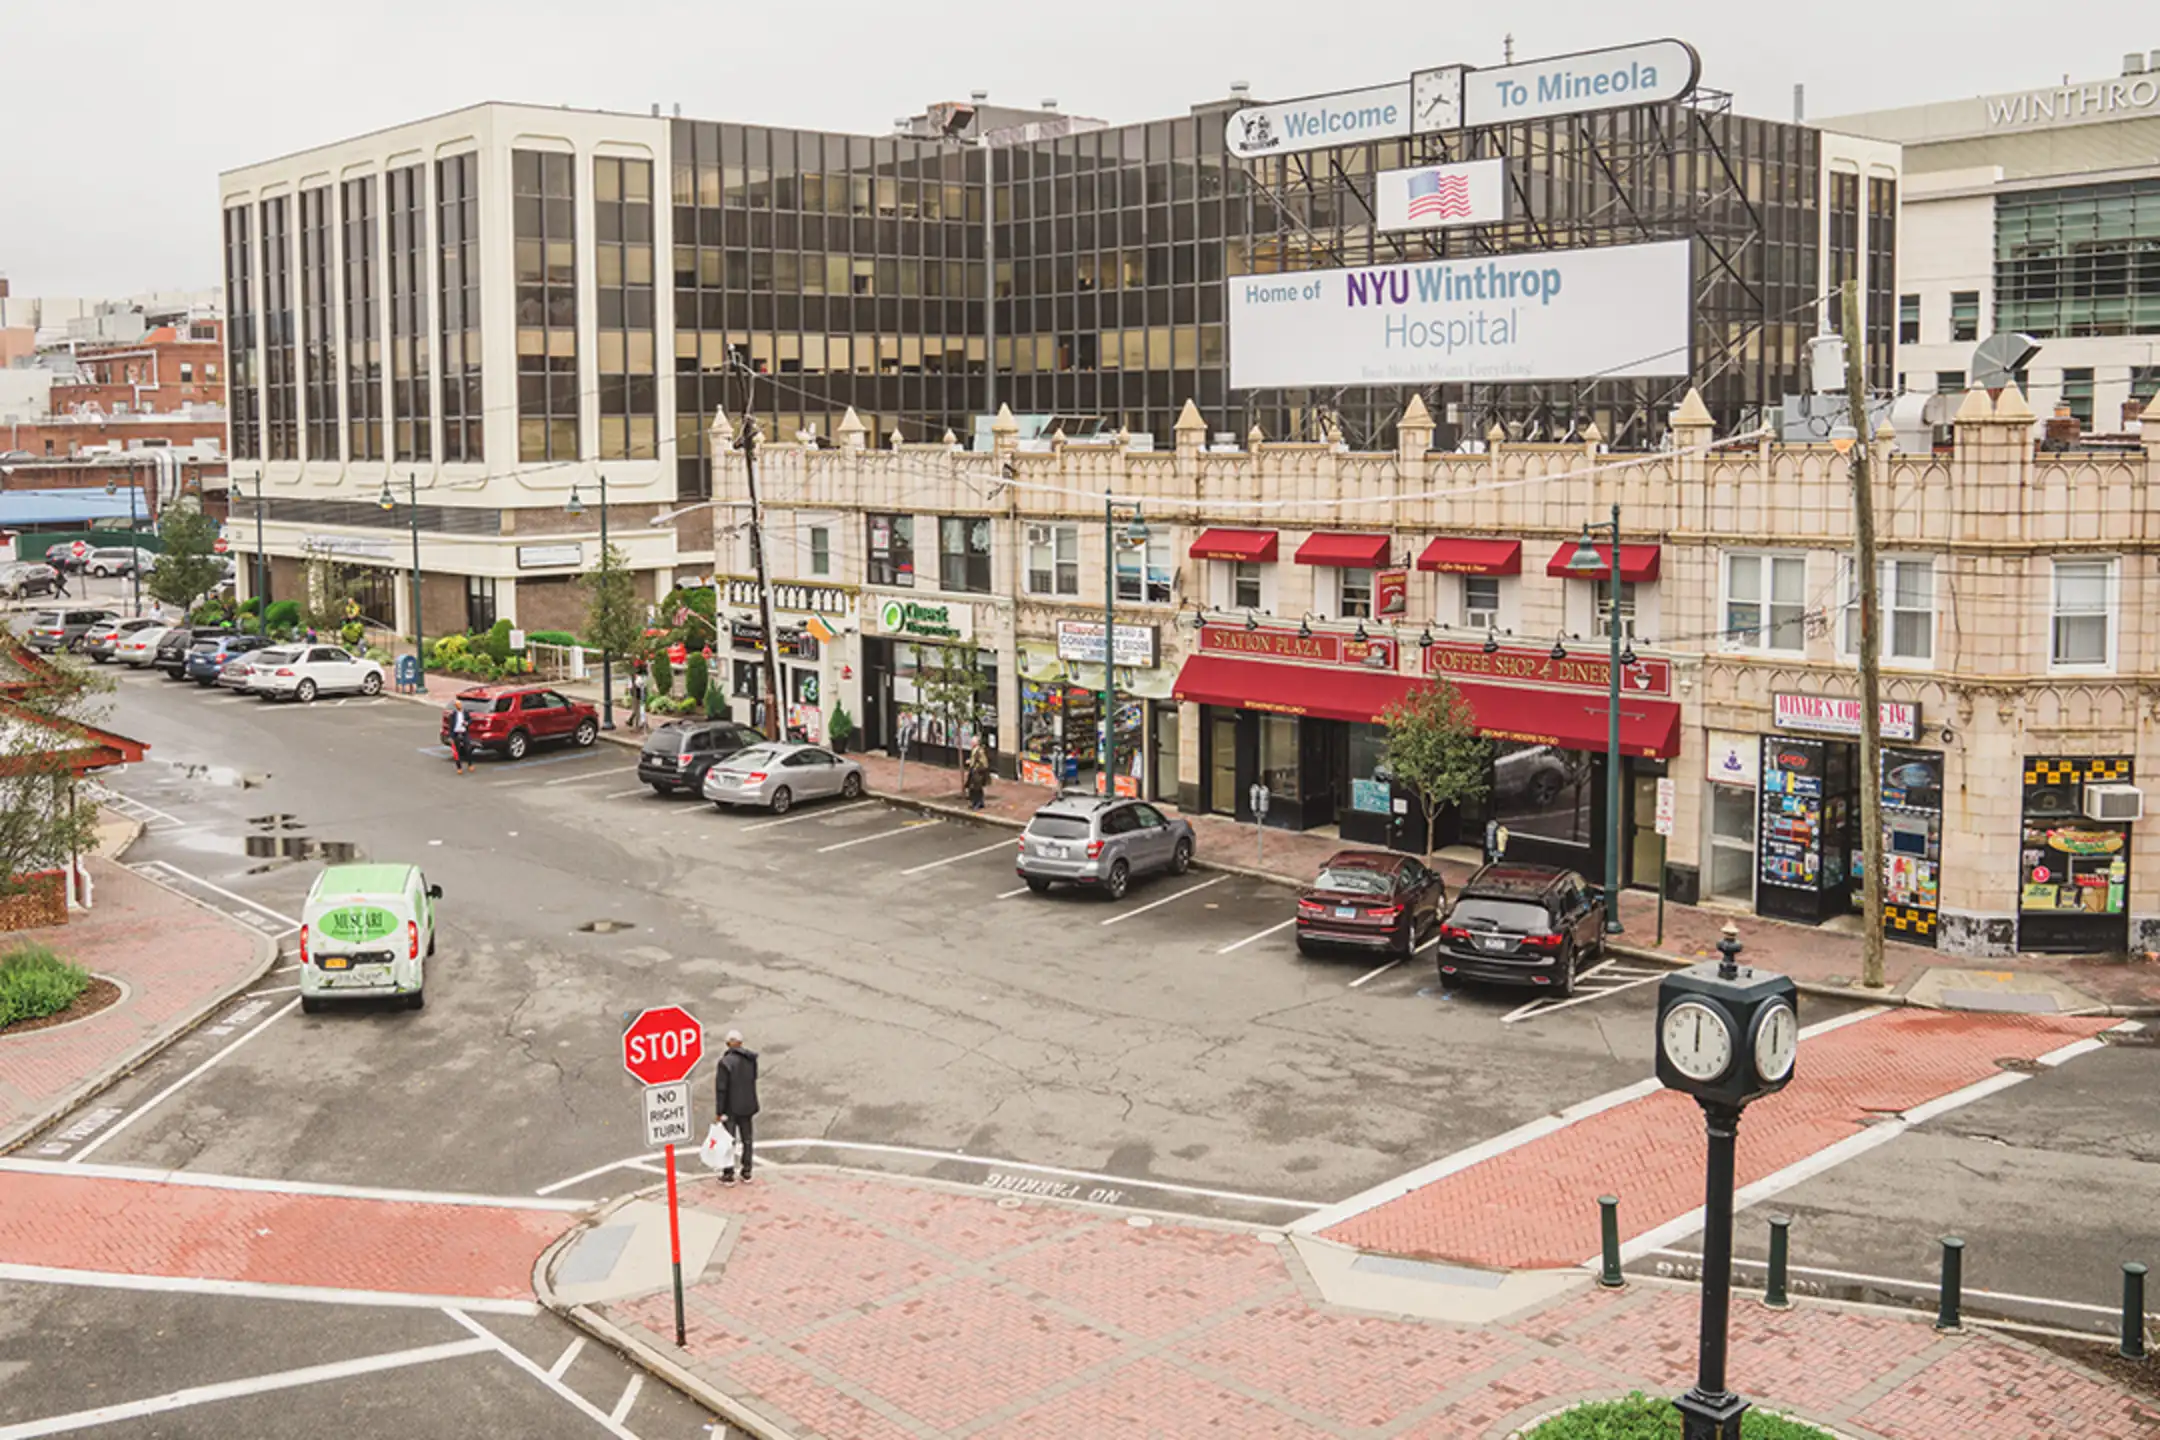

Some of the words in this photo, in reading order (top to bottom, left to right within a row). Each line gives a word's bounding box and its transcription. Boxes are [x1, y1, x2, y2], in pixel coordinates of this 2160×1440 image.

[1496, 80, 1528, 108] To
[1537, 61, 1658, 104] Mineola
[1986, 78, 2159, 124] WINTHRO
[1284, 104, 1398, 139] Welcome
[1246, 284, 1298, 304] Home
[1302, 280, 1322, 300] of
[1347, 269, 1410, 307] NYU
[1415, 262, 1562, 305] Winthrop
[1385, 307, 1518, 355] Hospital
[906, 602, 949, 622] Quest
[1214, 631, 1271, 651] STATION
[1275, 636, 1323, 657] PLAZA
[1432, 650, 1492, 671] COFFEE
[1495, 656, 1536, 676] SHOP
[1559, 663, 1612, 683] DINER
[1779, 695, 1834, 718] WINNER'S
[1837, 701, 1884, 724] CORR
[1778, 753, 1808, 768] OPEN
[629, 1028, 697, 1064] STOP
[657, 1090, 677, 1103] NO
[650, 1106, 685, 1121] RIGHT
[653, 1123, 685, 1138] TURN
[983, 1172, 1081, 1199] PARKING
